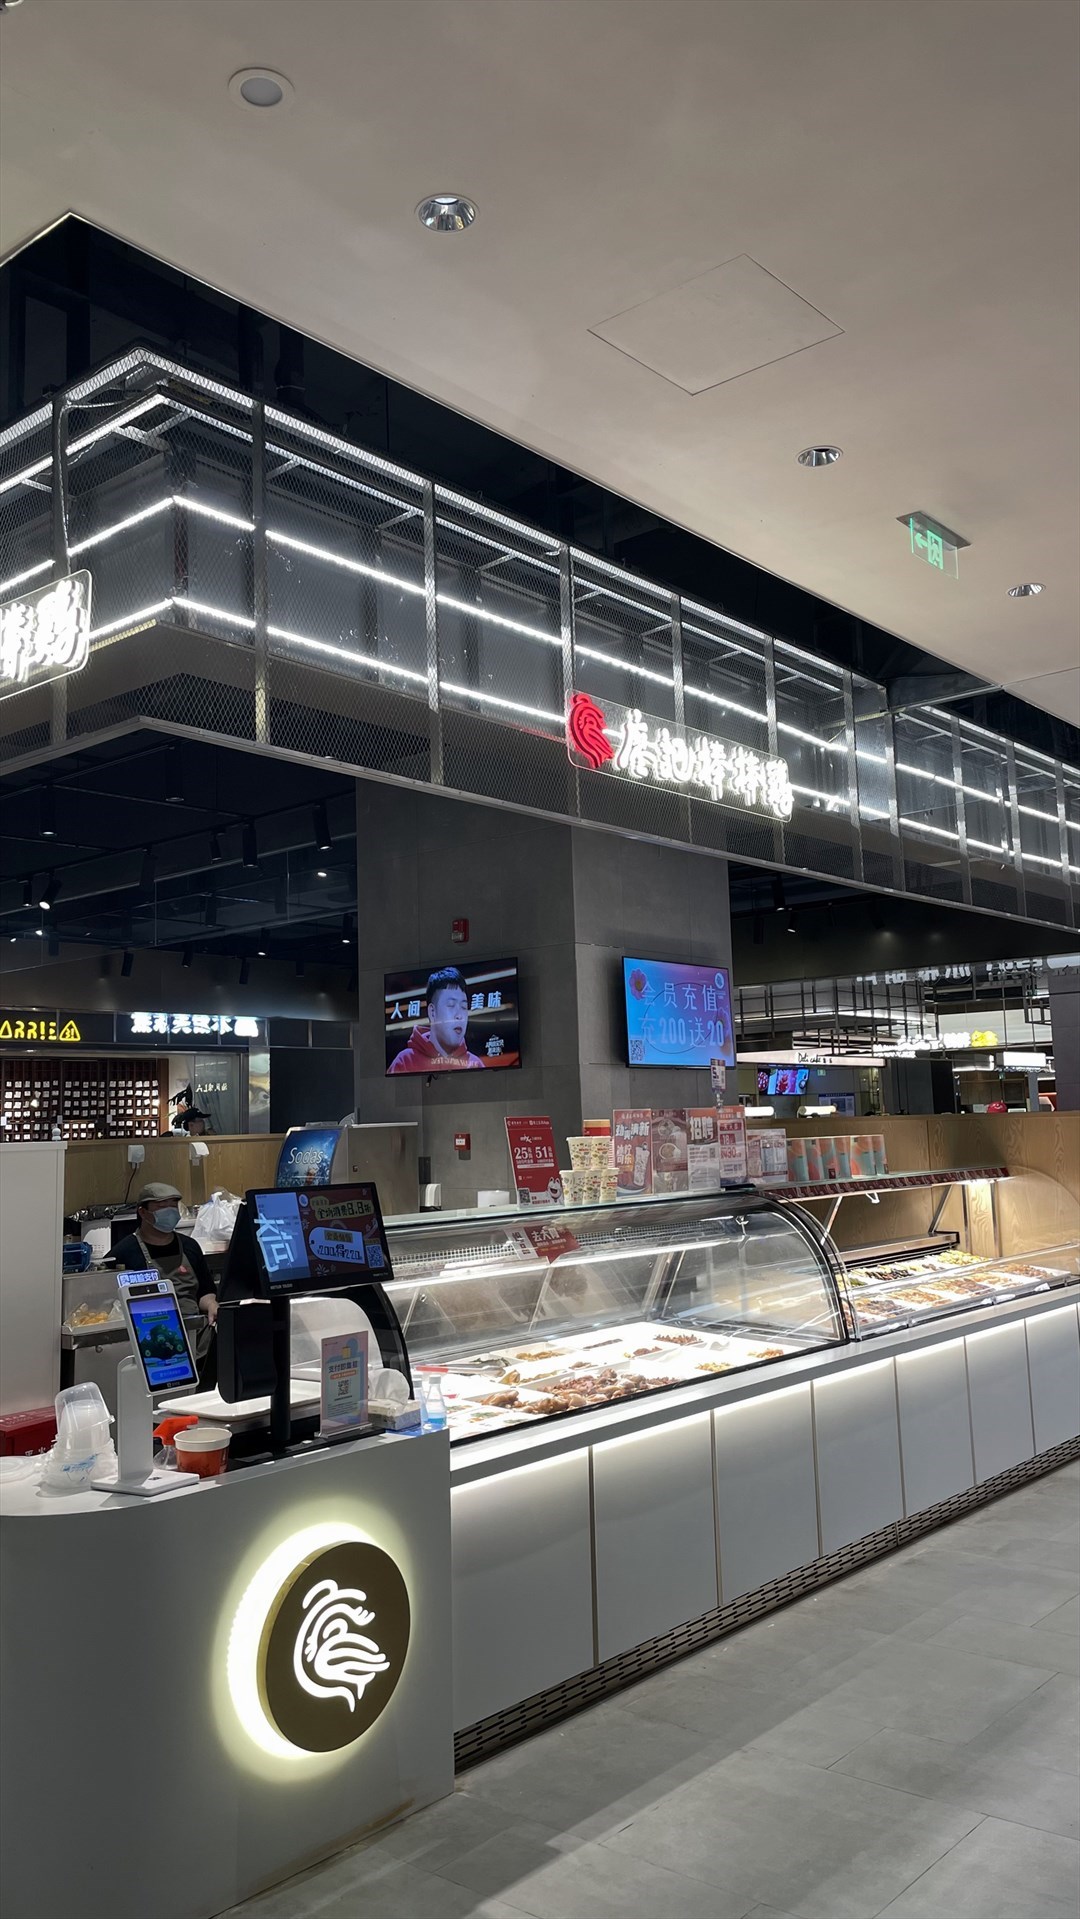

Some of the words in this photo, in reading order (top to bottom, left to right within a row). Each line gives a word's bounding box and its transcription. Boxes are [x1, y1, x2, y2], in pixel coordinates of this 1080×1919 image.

[390, 1000, 421, 1020] 人间
[470, 991, 502, 1011] 美味
[640, 982, 718, 1012] 会员充值
[690, 1116, 714, 1140] 招聘
[288, 1147, 324, 1165] Sodas
